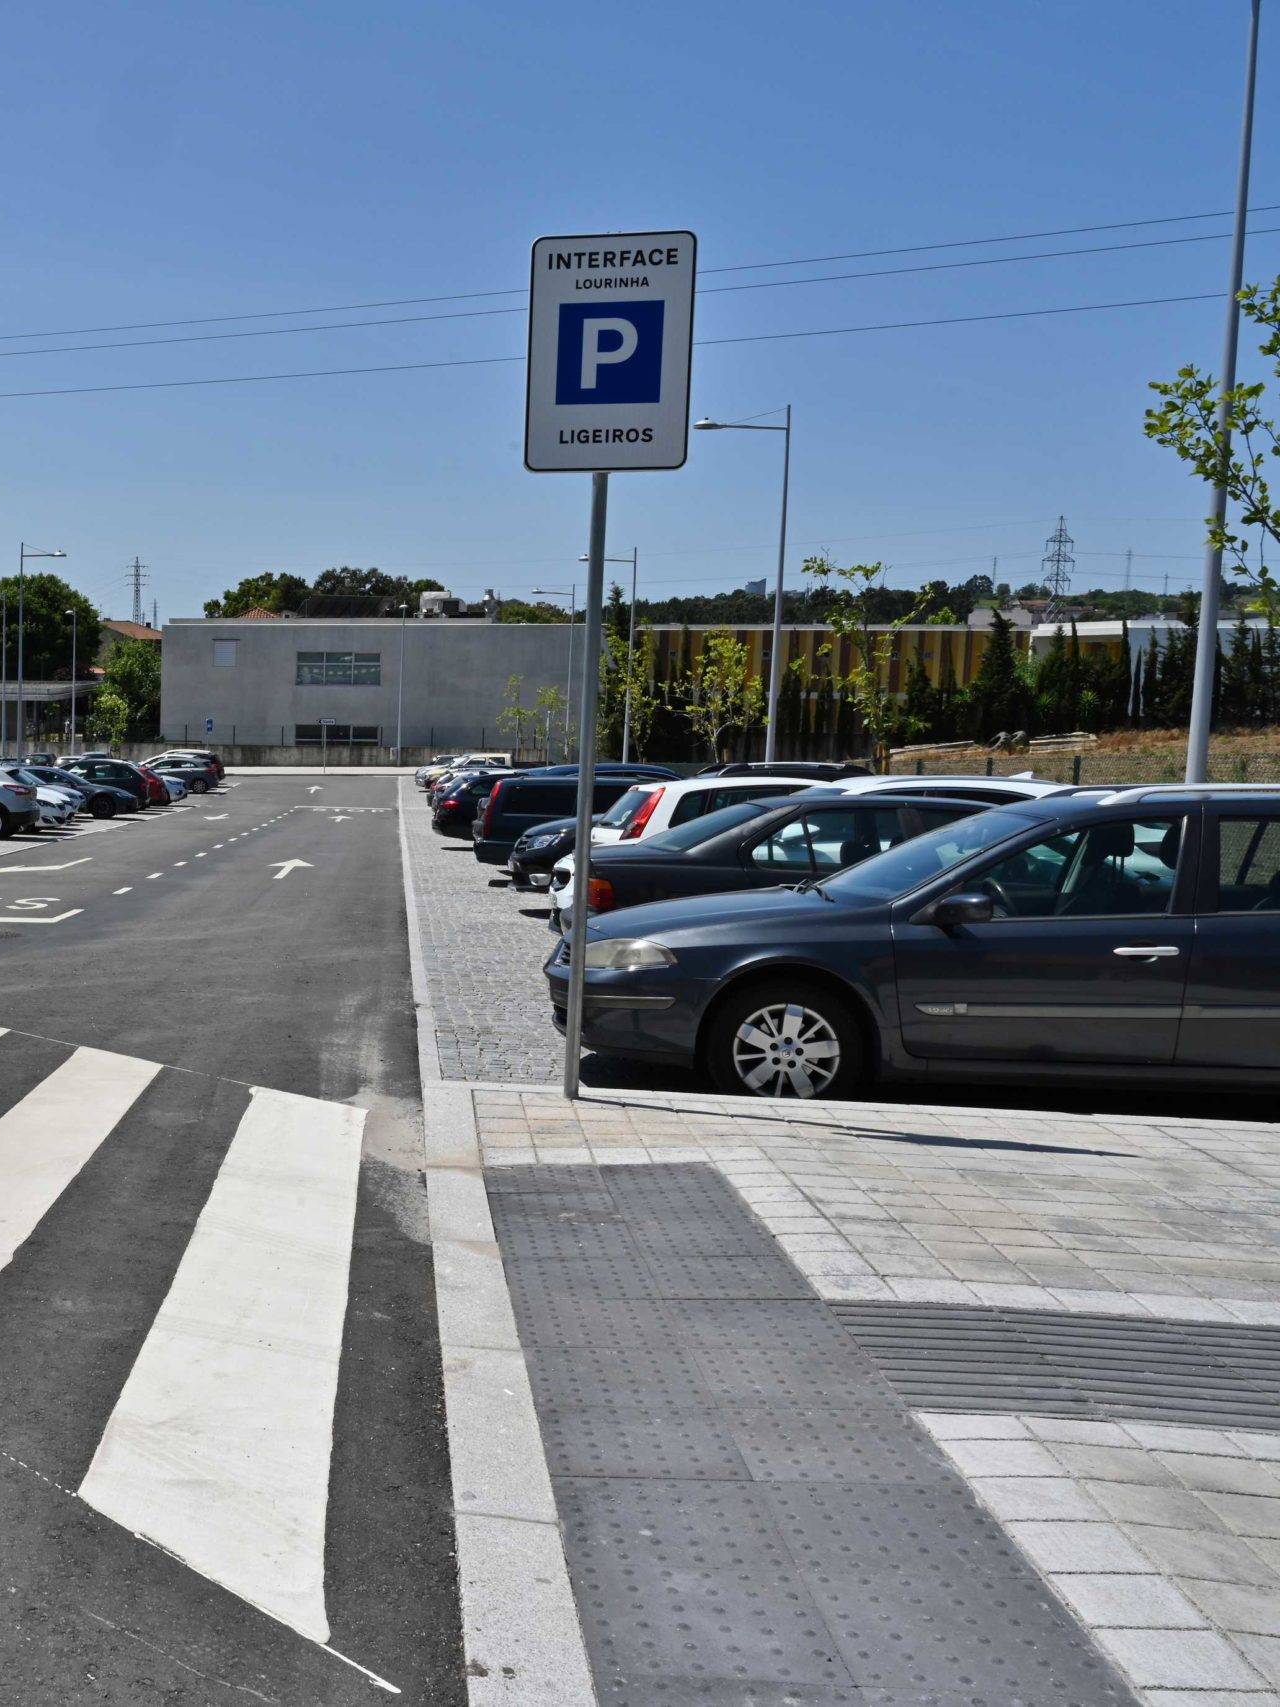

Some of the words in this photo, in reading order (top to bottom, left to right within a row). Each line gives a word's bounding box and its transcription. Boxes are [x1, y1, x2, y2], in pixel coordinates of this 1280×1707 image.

[548, 248, 679, 270] INTERFACE
[575, 277, 650, 290] LOURINHA
[580, 317, 639, 389] P
[559, 428, 654, 444] LIGEIROS
